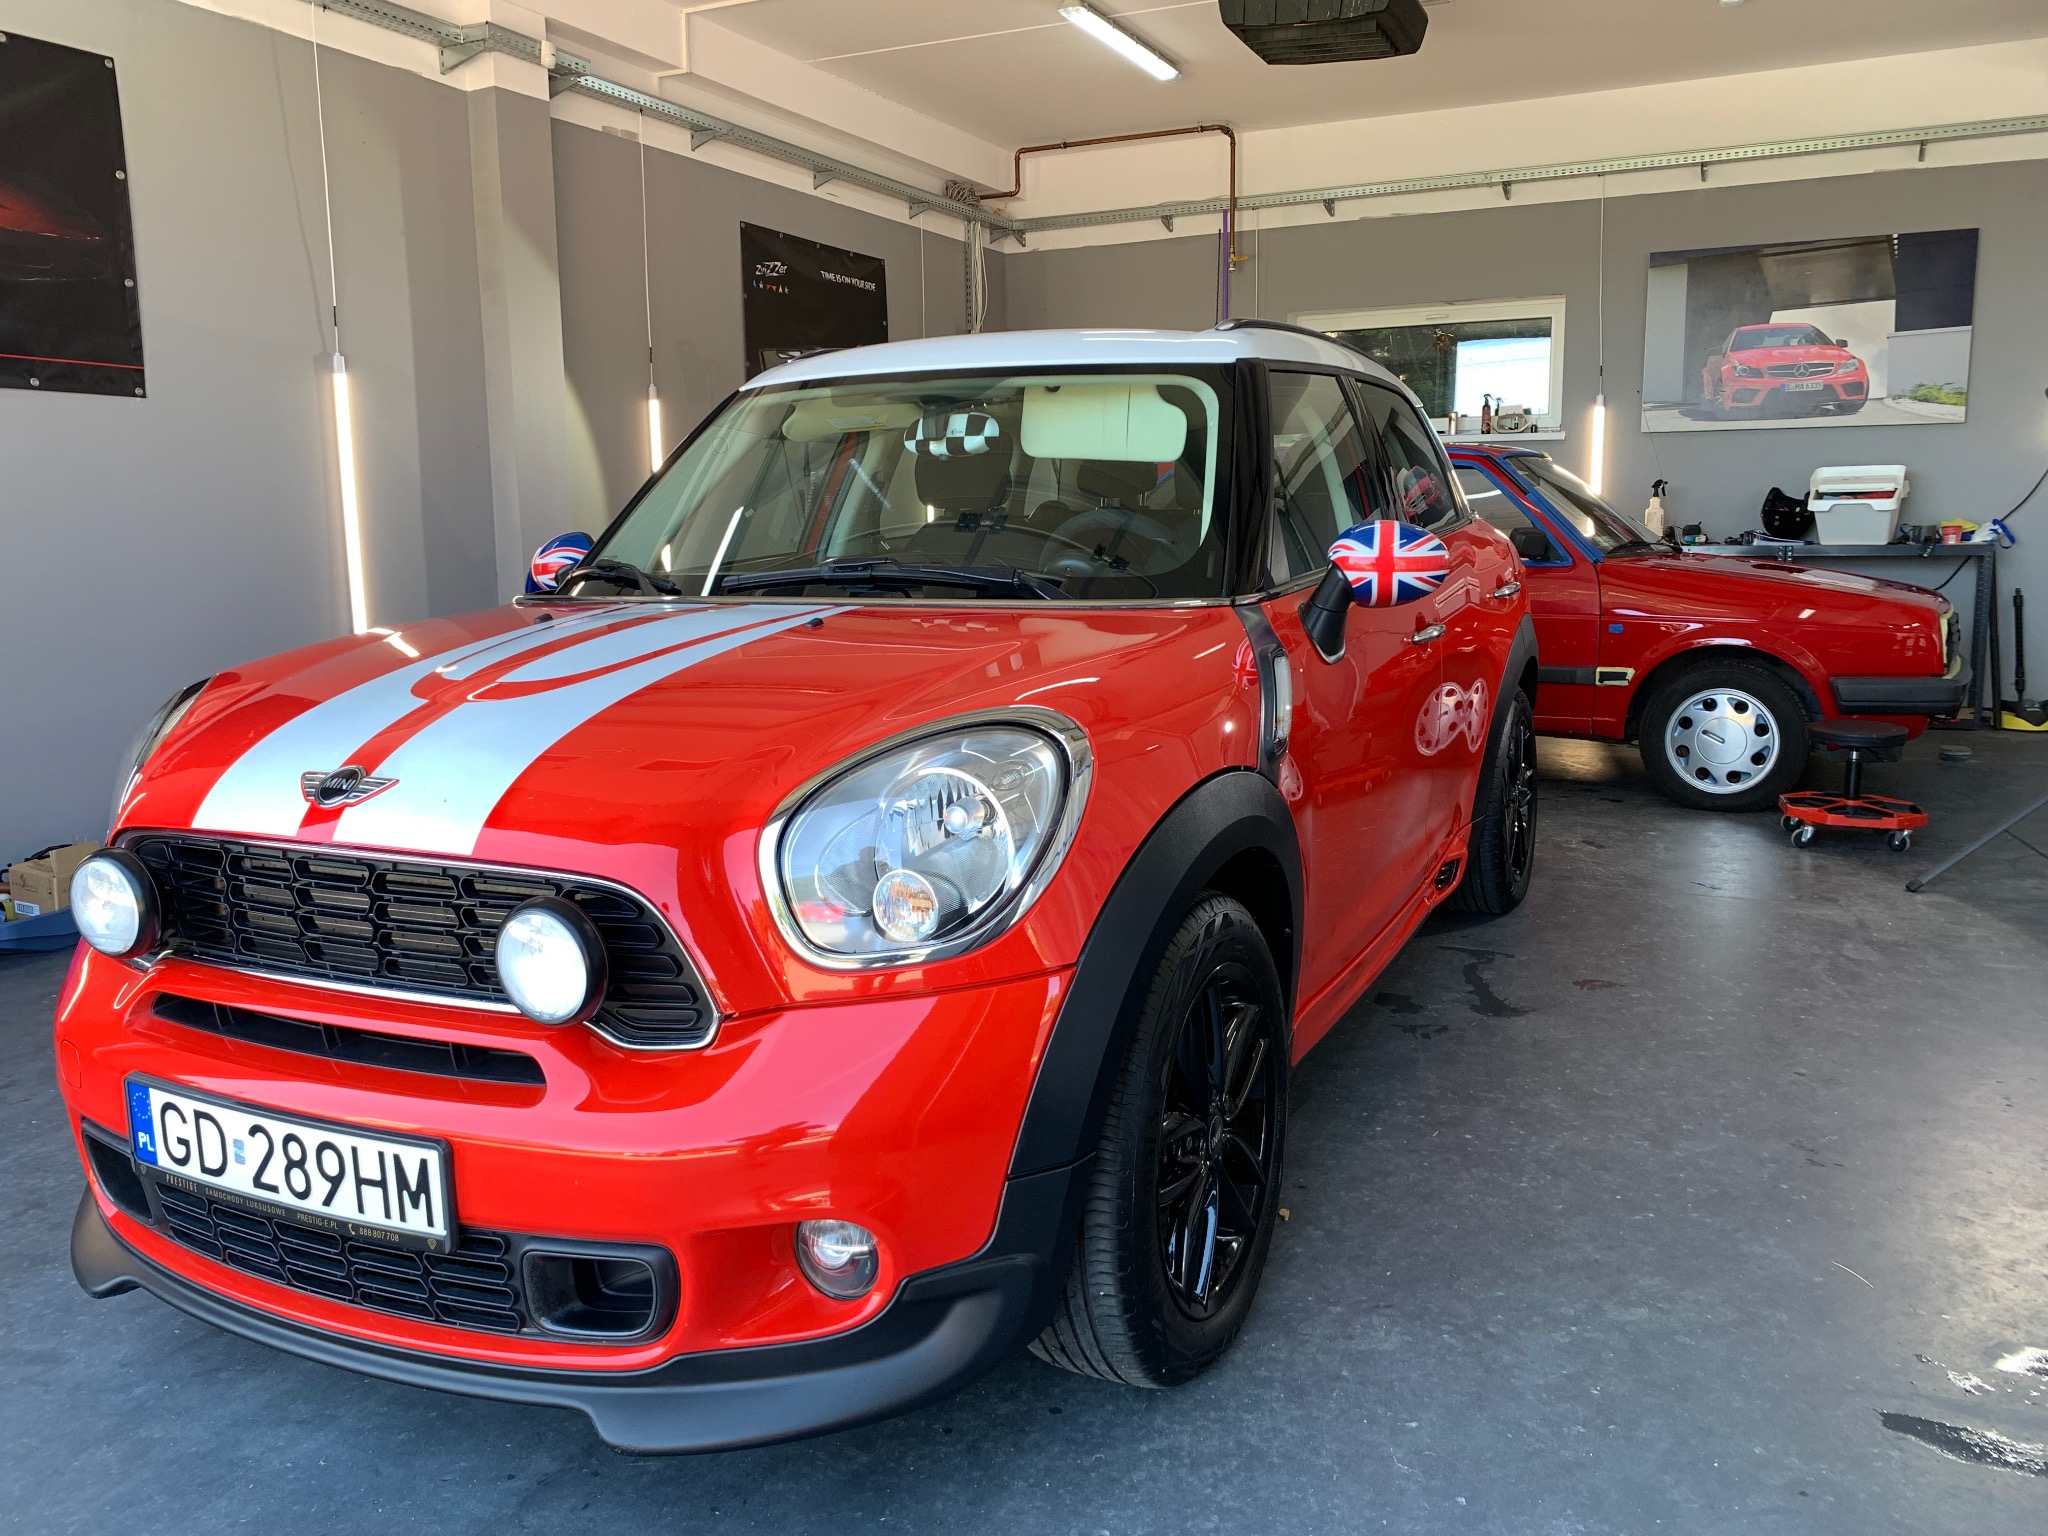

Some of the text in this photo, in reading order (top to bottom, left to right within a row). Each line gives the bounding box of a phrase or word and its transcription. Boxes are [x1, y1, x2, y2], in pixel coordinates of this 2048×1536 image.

[820, 270, 836, 282] TIME
[841, 275, 851, 284] ON
[851, 277, 865, 289] YOUR
[865, 281, 876, 291] SIDE
[323, 777, 356, 790] MINI
[138, 1131, 155, 1152] PL
[160, 1101, 435, 1228] GD 289HM
[165, 1173, 198, 1193] PRESTIGE
[205, 1187, 244, 1205] SAMOCHODY
[246, 1199, 286, 1217] LUKSUSOWE
[359, 1226, 372, 1237] 888
[372, 1229, 386, 1240] 807
[386, 1232, 400, 1242] 708
